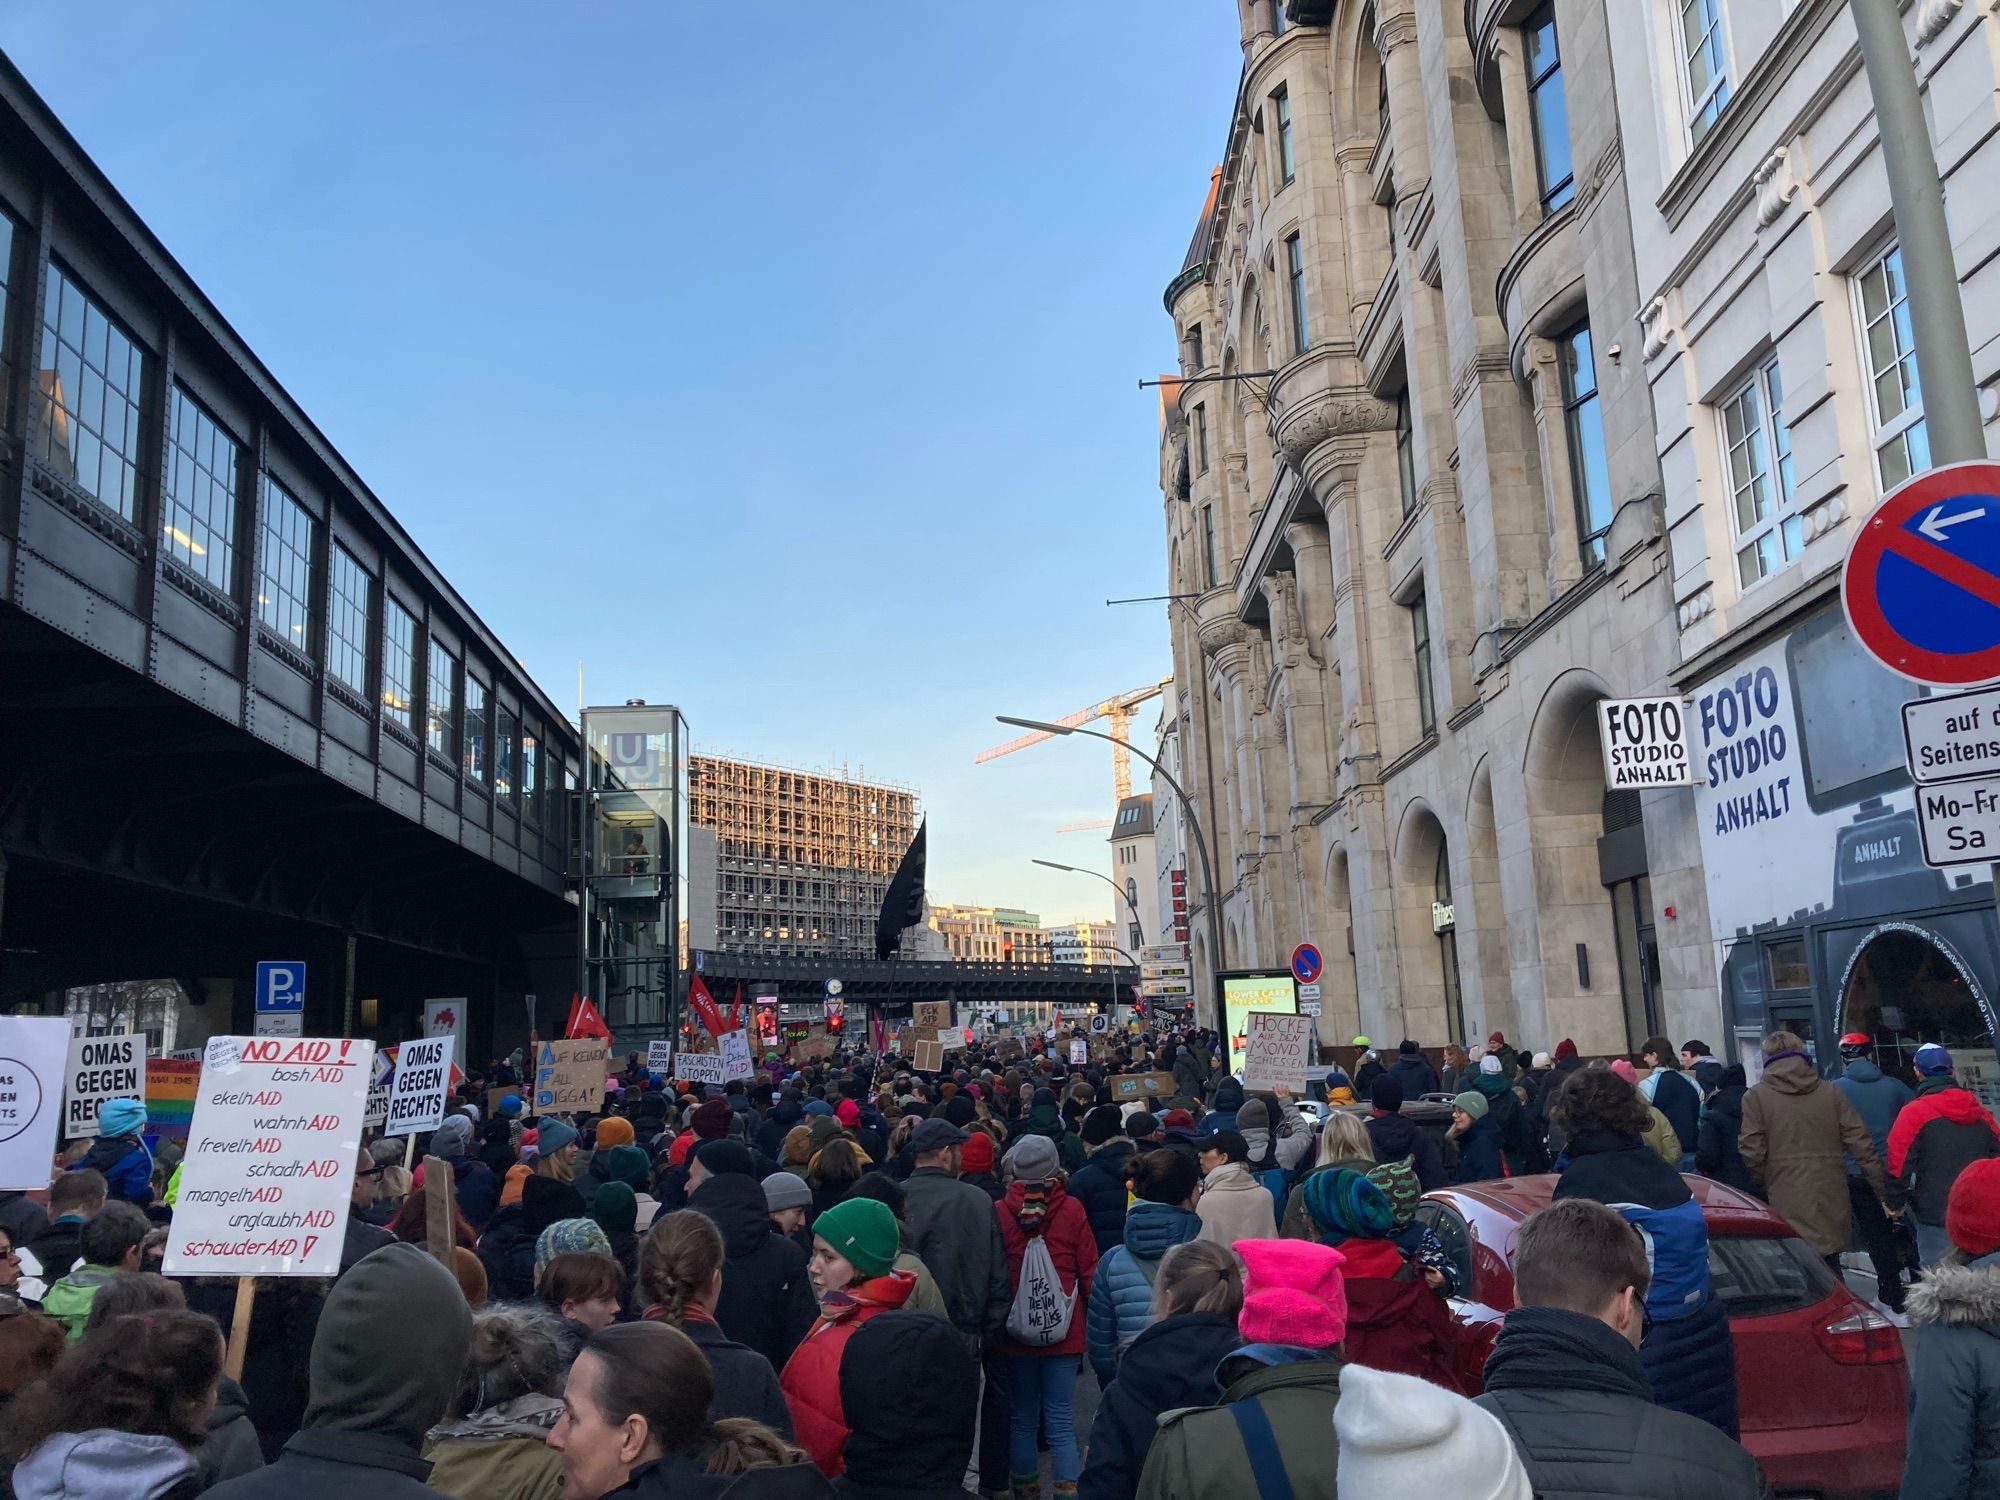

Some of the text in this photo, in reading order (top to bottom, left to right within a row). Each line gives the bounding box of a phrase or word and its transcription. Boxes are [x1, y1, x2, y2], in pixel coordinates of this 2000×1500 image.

[1700, 666, 1778, 748] FOTO
[1607, 702, 1681, 746] FOTO
[1945, 707, 1980, 734] auf
[615, 735, 642, 764] U
[1611, 743, 1684, 766] STUDIO
[1708, 725, 1786, 789] STUDIO
[1615, 763, 1687, 785] ANHALT
[1716, 776, 1790, 836] ANHALT
[1927, 790, 1999, 821] Mo-Fr
[1854, 835, 1902, 864] ANHALT
[1947, 827, 1986, 851] Sa
[1933, 936, 1972, 985] Fotoarbeiten
[1969, 983, 1980, 999] ab
[1977, 1000, 1987, 1013] 60
[268, 969, 294, 1005] P
[1254, 1015, 1307, 1034] HÖCKE
[1250, 1040, 1300, 1056] MOND
[1258, 1033, 1301, 1042] AUF DEN
[82, 1042, 133, 1066] OMAS
[242, 1041, 281, 1060] NO
[283, 1042, 331, 1062] AfD
[407, 1043, 443, 1067] OMAS
[539, 1044, 607, 1066] AUF KEINEN
[676, 1054, 725, 1069] FASCHISTEN
[1247, 1055, 1306, 1069] SCHIESSEN
[648, 1060, 667, 1068] RECHTS
[681, 1067, 720, 1081] STOPPEN
[76, 1068, 137, 1094] GEGEN
[399, 1068, 443, 1094] GEGEN
[390, 1094, 442, 1120] RECHTS
[537, 1088, 595, 1108] DIGGA!
[1028, 1311, 1043, 1327] WE
